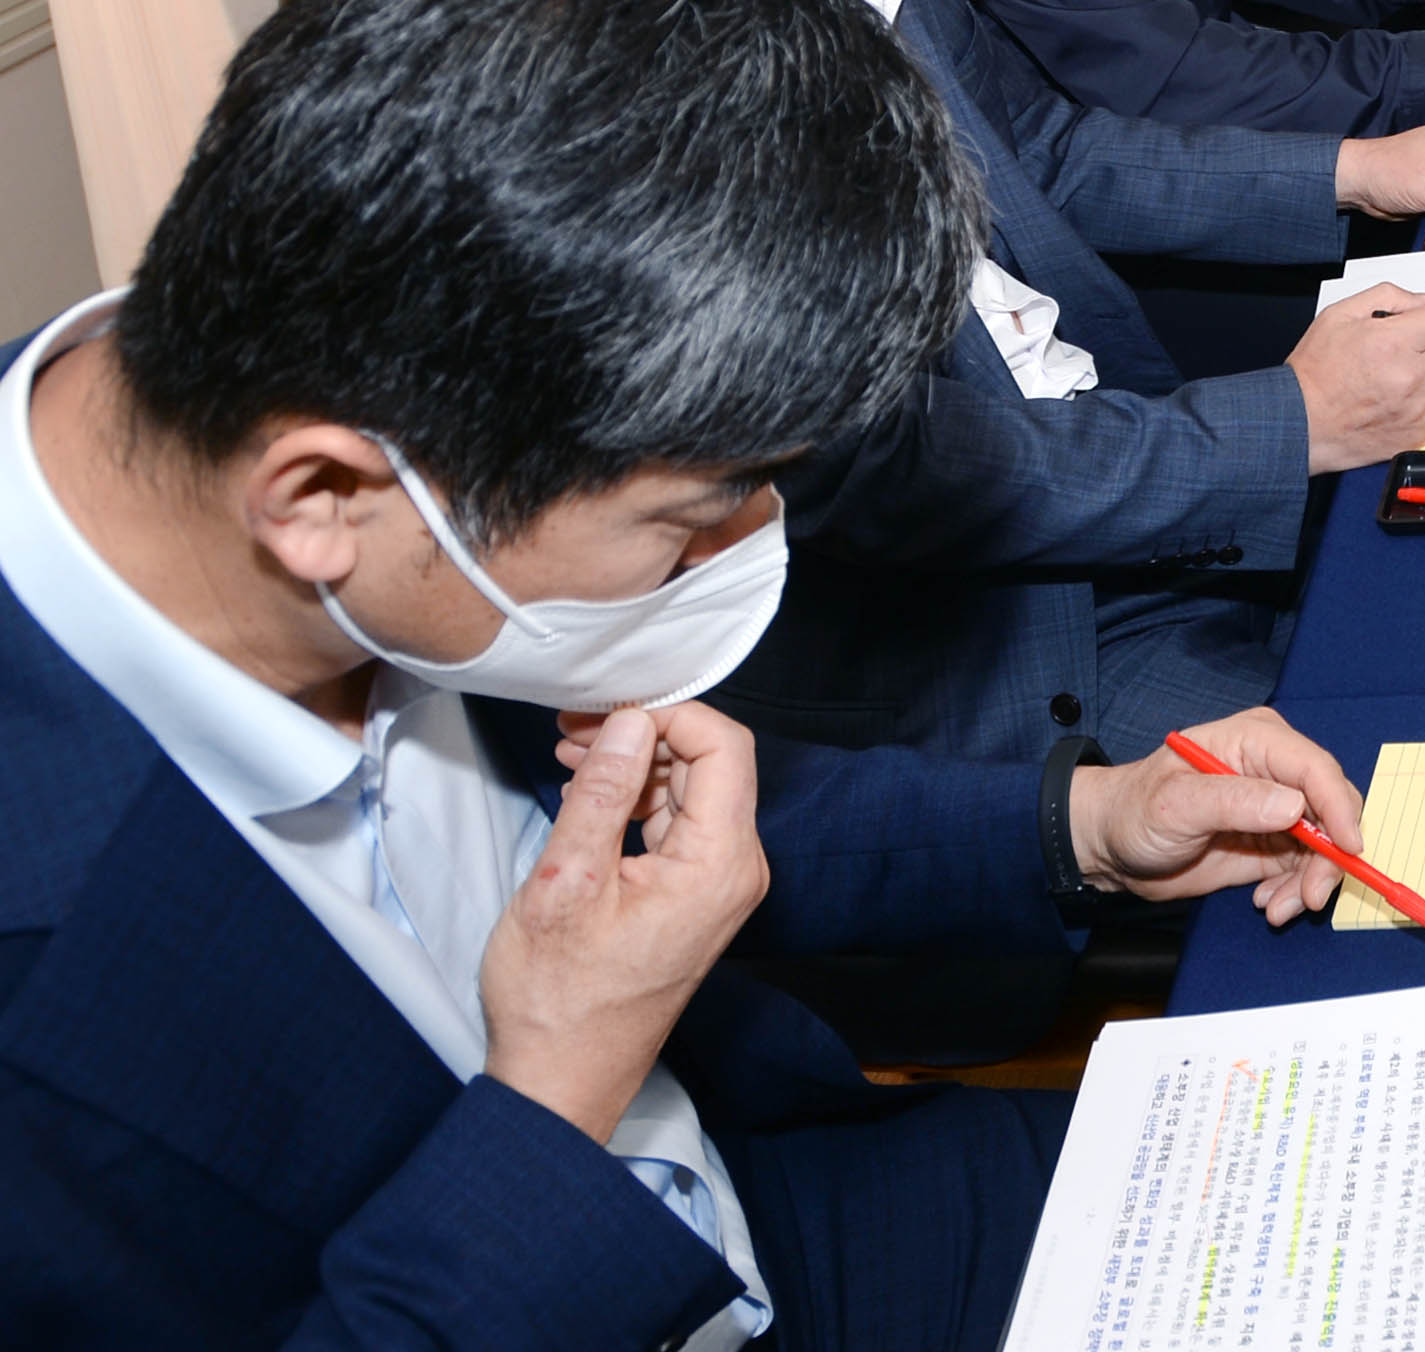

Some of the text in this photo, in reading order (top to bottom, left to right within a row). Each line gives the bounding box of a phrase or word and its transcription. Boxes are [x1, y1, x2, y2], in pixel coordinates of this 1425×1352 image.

[1170, 1071, 1191, 1101] 소부장
[1140, 1113, 1161, 1140] 신산업
[1164, 1106, 1183, 1126] 산업
[1152, 1132, 1176, 1172] 생태계의
[1273, 1133, 1292, 1156] R&D
[1345, 1143, 1363, 1164] 국내
[1339, 1169, 1359, 1202] 소부장
[1117, 1185, 1142, 1223] 선도하기
[1111, 1228, 1131, 1248] 위한
[1333, 1207, 1353, 1241] 기업의
[1101, 1253, 1124, 1283] 새정부
[1091, 1290, 1115, 1321] 소부장
[1110, 1296, 1135, 1332] 글로벌
